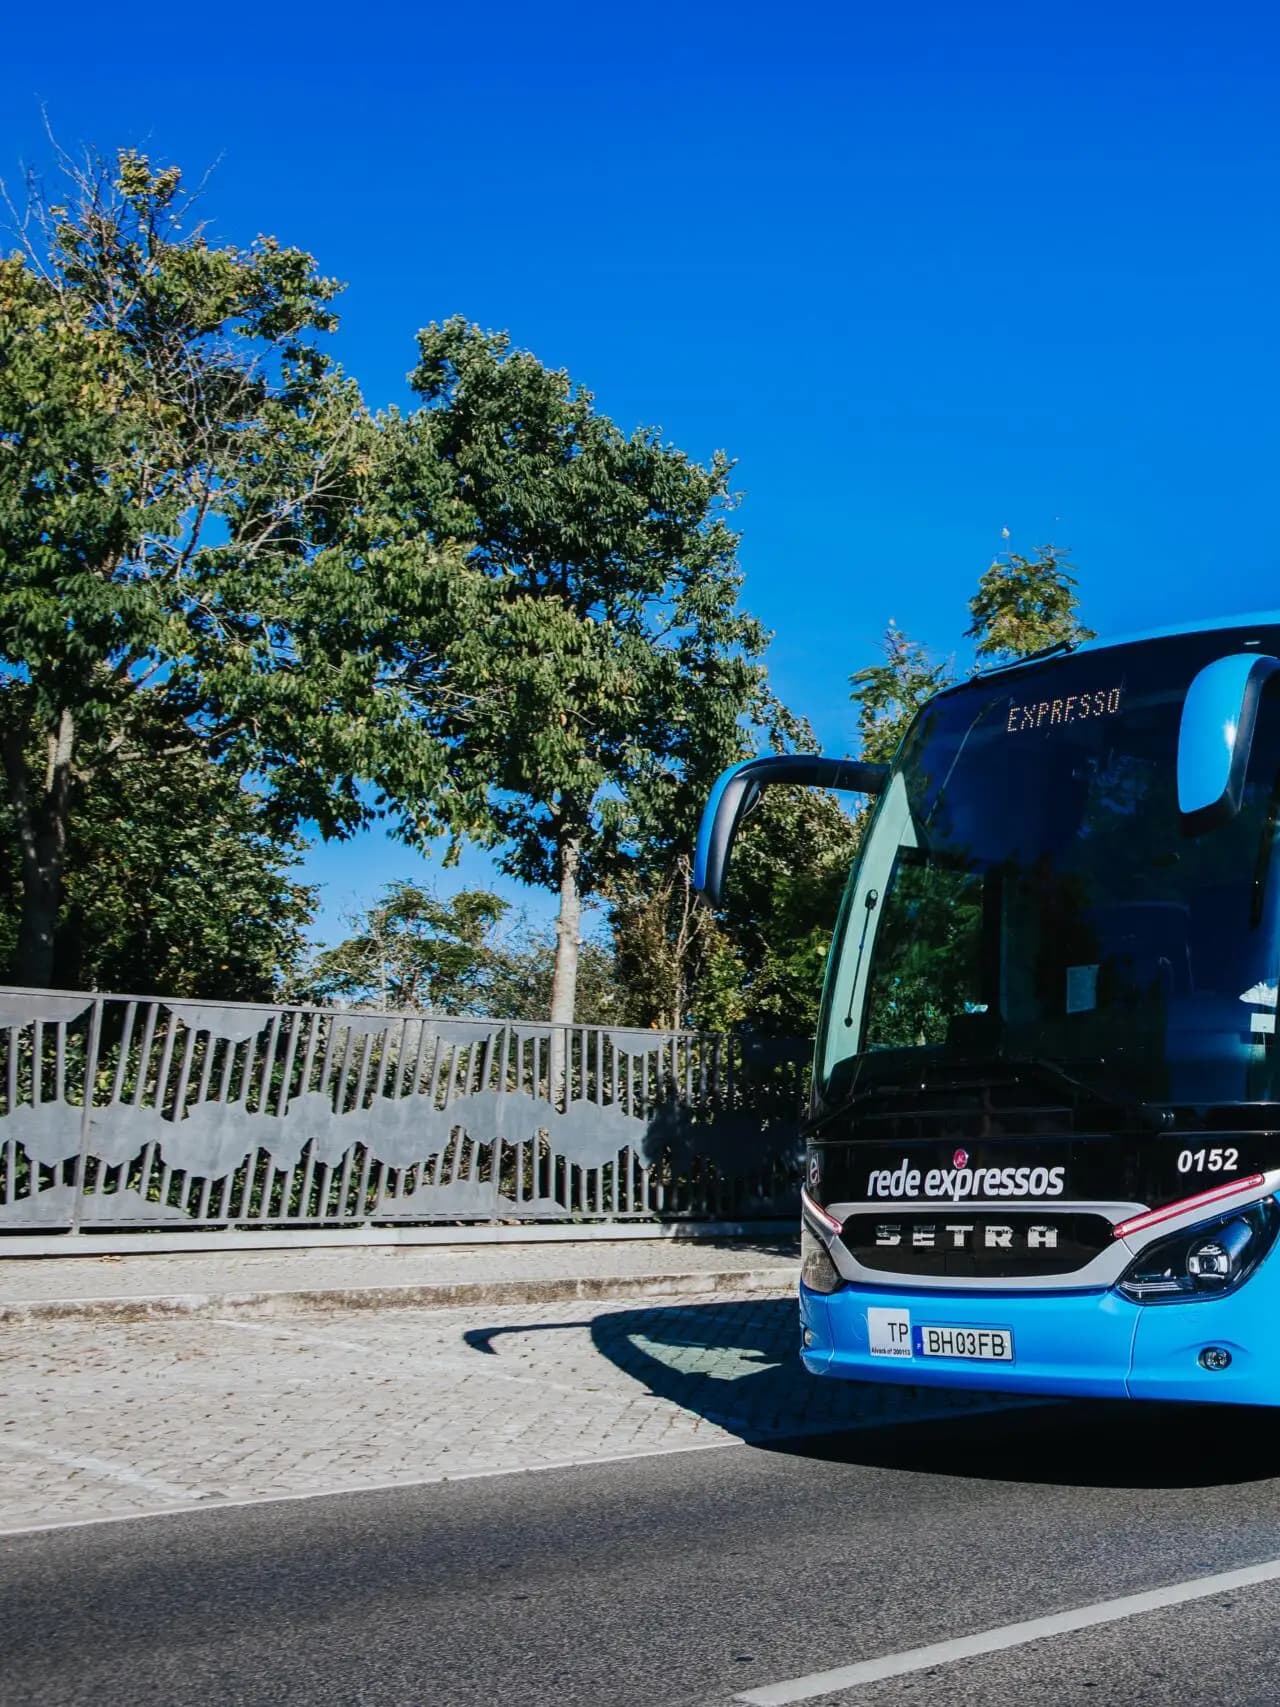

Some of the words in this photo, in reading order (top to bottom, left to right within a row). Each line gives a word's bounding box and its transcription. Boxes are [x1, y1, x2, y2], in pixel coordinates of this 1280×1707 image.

[1007, 688, 1119, 732] EXPRESSO
[1177, 1147, 1239, 1173] 0152
[867, 1158, 921, 1197] rede
[924, 1166, 1065, 1202] expressos
[875, 1224, 1058, 1248] SETRA
[887, 1322, 909, 1343] TP
